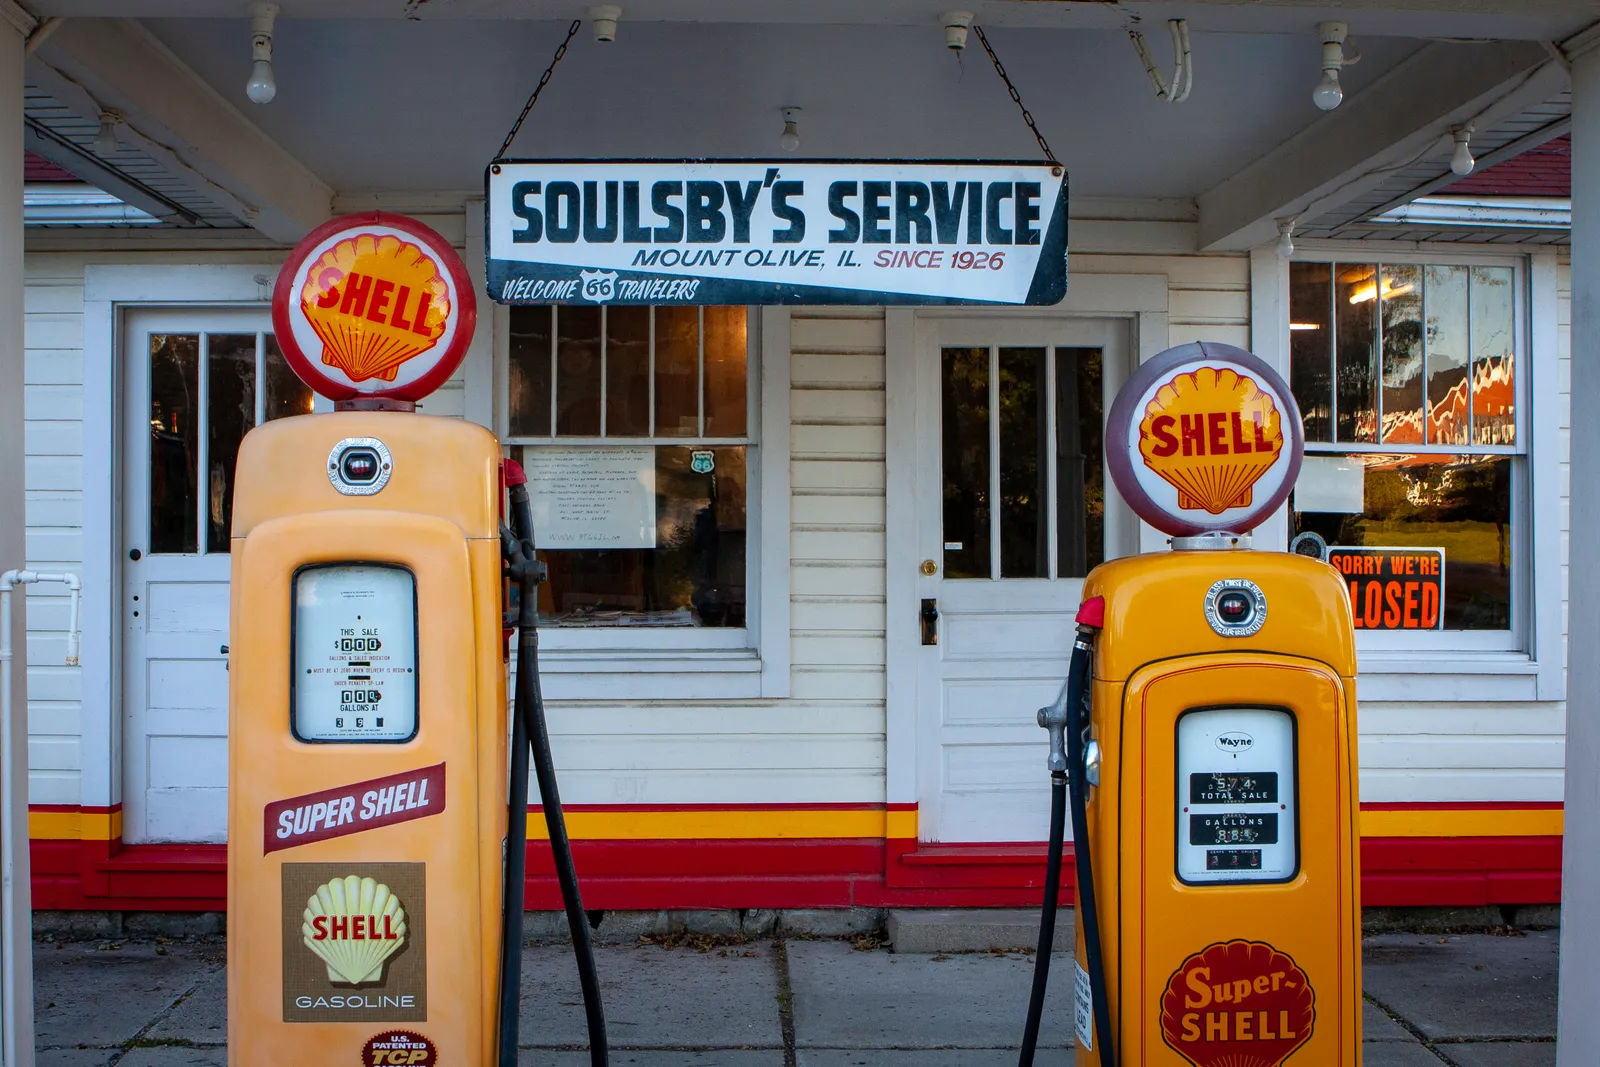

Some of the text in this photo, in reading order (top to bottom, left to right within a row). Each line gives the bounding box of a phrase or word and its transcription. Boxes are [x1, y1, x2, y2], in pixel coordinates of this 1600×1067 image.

[512, 168, 1041, 246] SOULSBY'S SERVICE
[631, 248, 1004, 272] MOUNT OLIVE, IL. SINCE 1926
[502, 276, 700, 300] WELCOME 66 TRAVELERS
[313, 266, 433, 337] SHELL
[1151, 411, 1274, 457] SHELL
[1332, 555, 1439, 575] SORRY WE'RE
[1350, 580, 1440, 628] LOSED
[361, 628, 378, 636] SALE
[340, 704, 379, 712] GALLONS AT
[1219, 737, 1252, 747] Wayne
[1201, 791, 1268, 800] TOTAL SALE
[276, 778, 429, 839] SUPER SHELL
[1205, 818, 1263, 826] GALLONS
[311, 914, 398, 941] SHELL
[295, 995, 416, 1008] GASOLINE
[1180, 1009, 1297, 1043] SHELL
[371, 1049, 428, 1065] TCP
